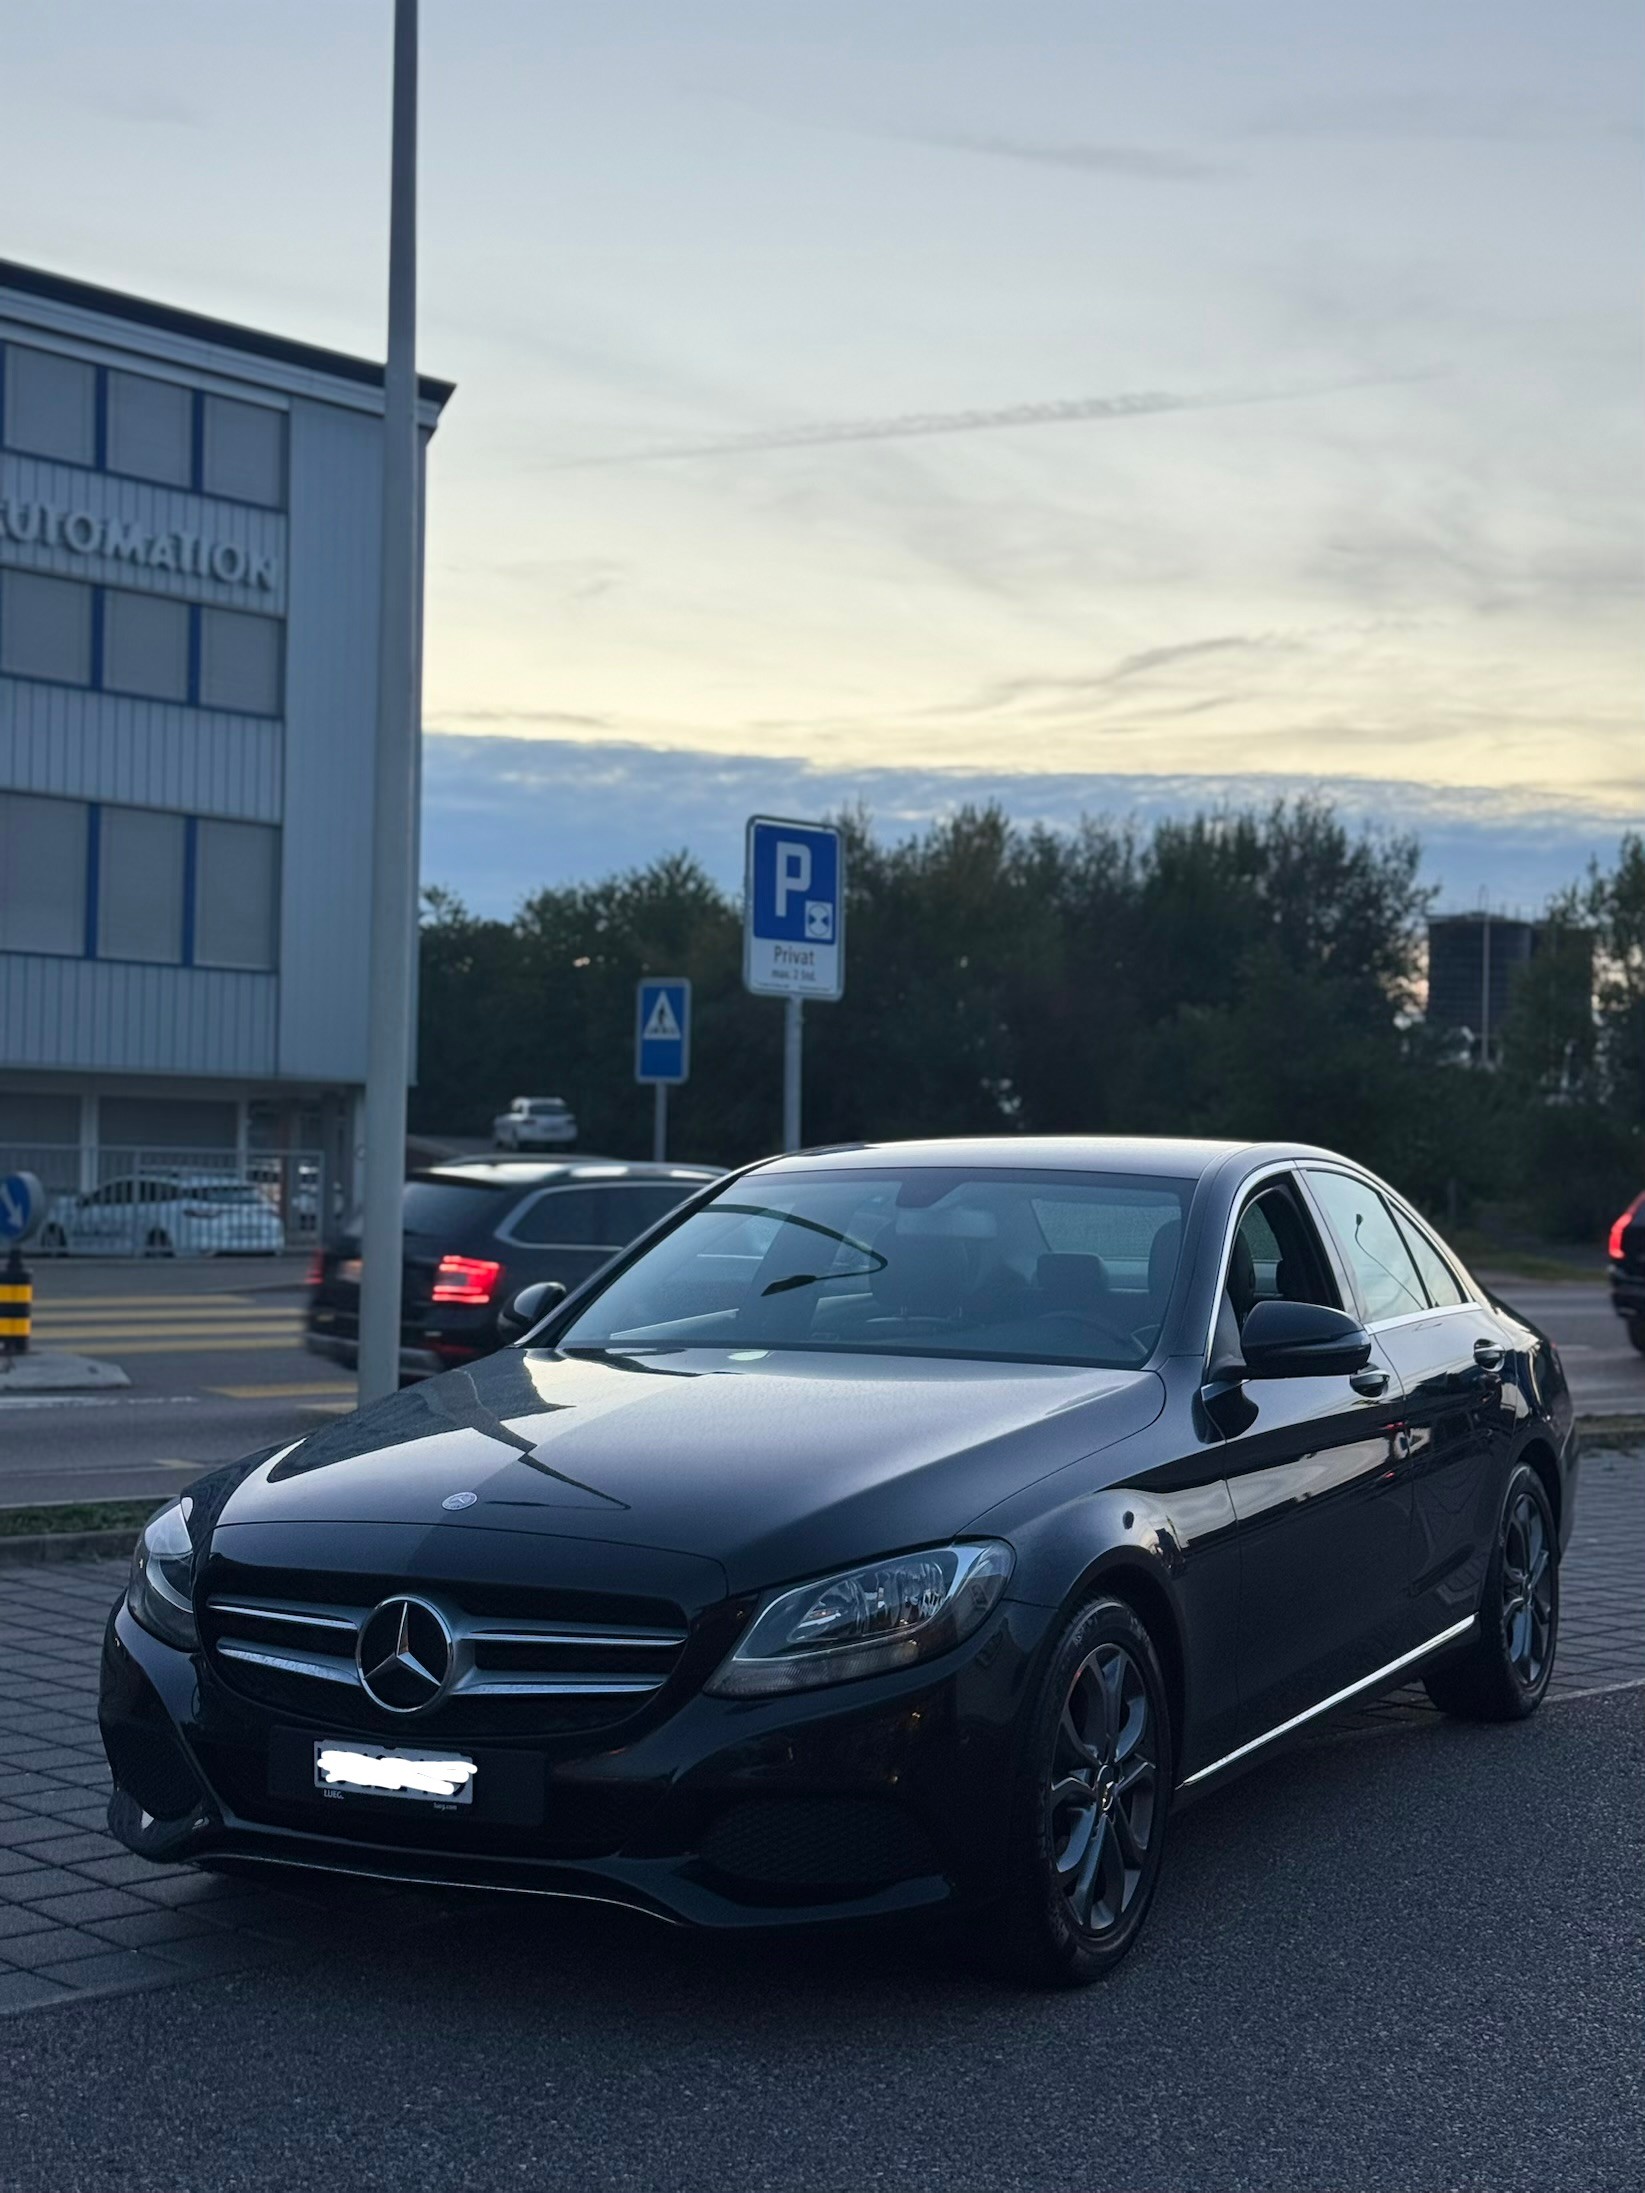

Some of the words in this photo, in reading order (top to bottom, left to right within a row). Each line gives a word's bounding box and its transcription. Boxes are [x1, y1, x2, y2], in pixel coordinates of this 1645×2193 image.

[0, 500, 277, 591] UTOMATION
[775, 841, 812, 918] P
[774, 945, 816, 966] Privat
